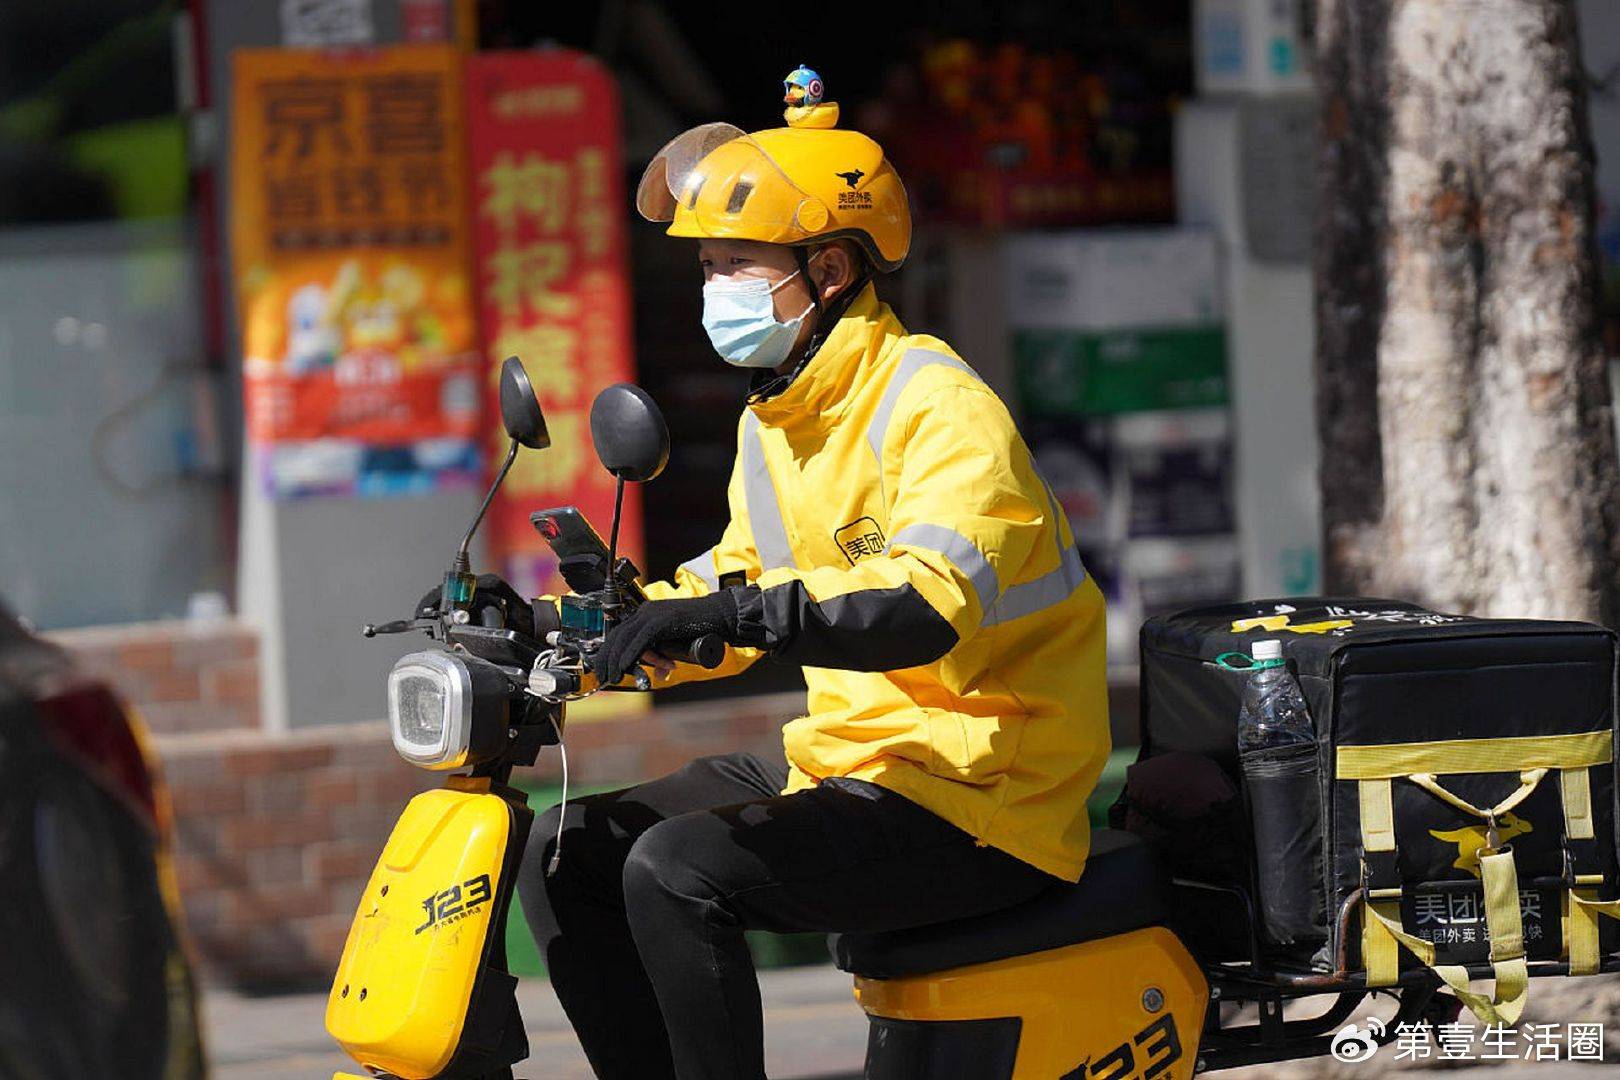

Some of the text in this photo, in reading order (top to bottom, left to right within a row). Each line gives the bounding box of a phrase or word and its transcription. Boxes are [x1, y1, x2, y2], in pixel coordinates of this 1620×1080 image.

[845, 532, 883, 560] 美团
[1414, 889, 1542, 924] 美团卖
